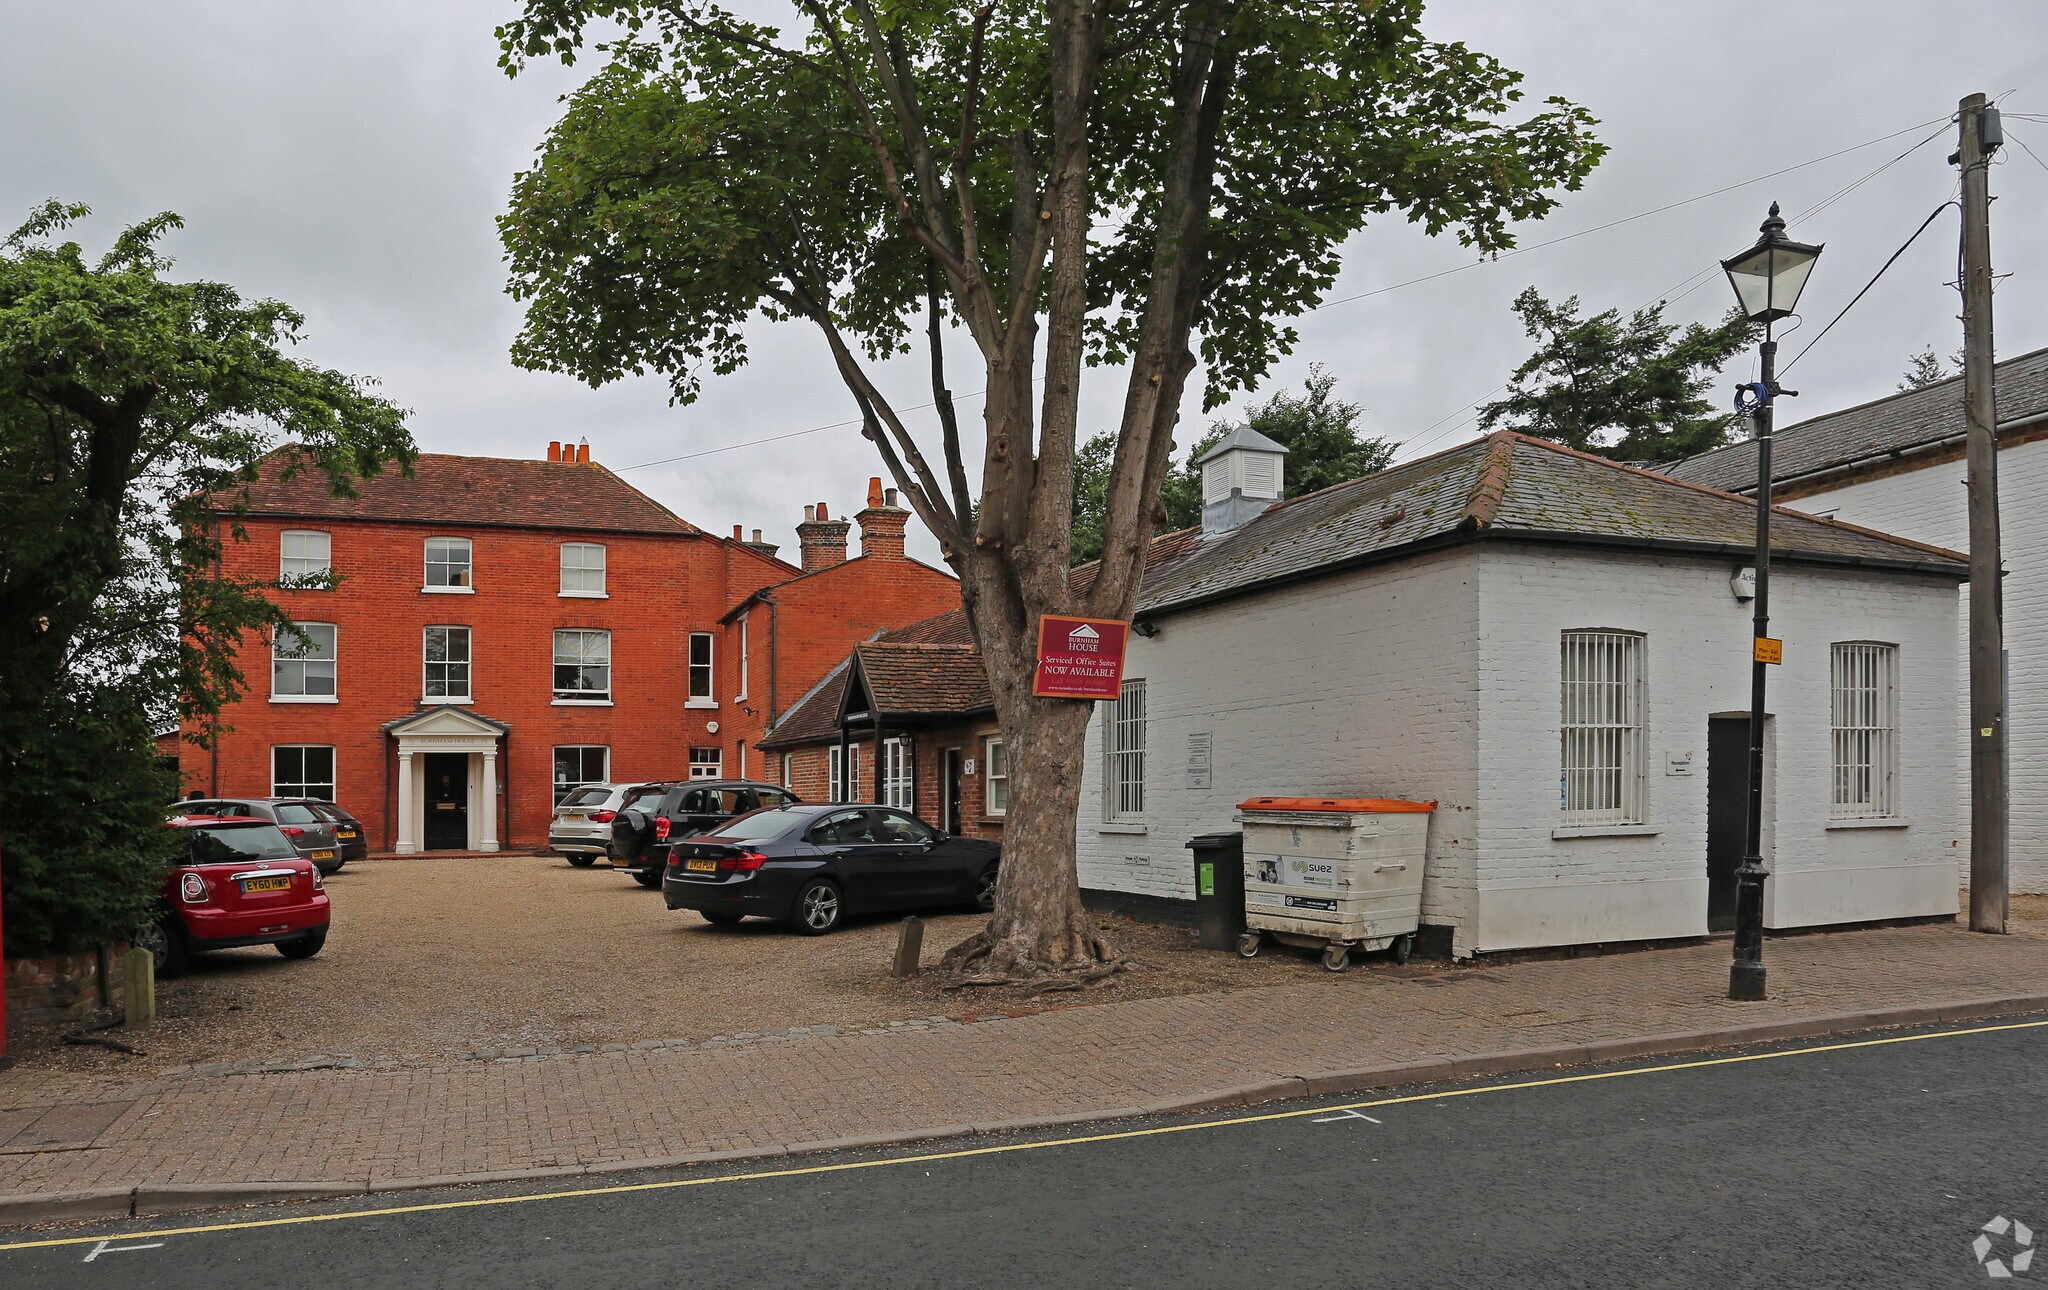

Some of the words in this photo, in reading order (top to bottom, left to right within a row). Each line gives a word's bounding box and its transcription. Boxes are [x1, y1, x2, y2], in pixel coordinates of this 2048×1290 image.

[1068, 643, 1098, 652] HOUSE
[1045, 655, 1073, 664] Serviced
[1075, 657, 1096, 666] Office
[1099, 659, 1116, 667] Suites
[1044, 665, 1068, 675] NOW
[1069, 667, 1115, 678] AVAILABLE
[1308, 864, 1332, 873] suez
[246, 879, 271, 890] EY60
[271, 878, 288, 888] HWP
